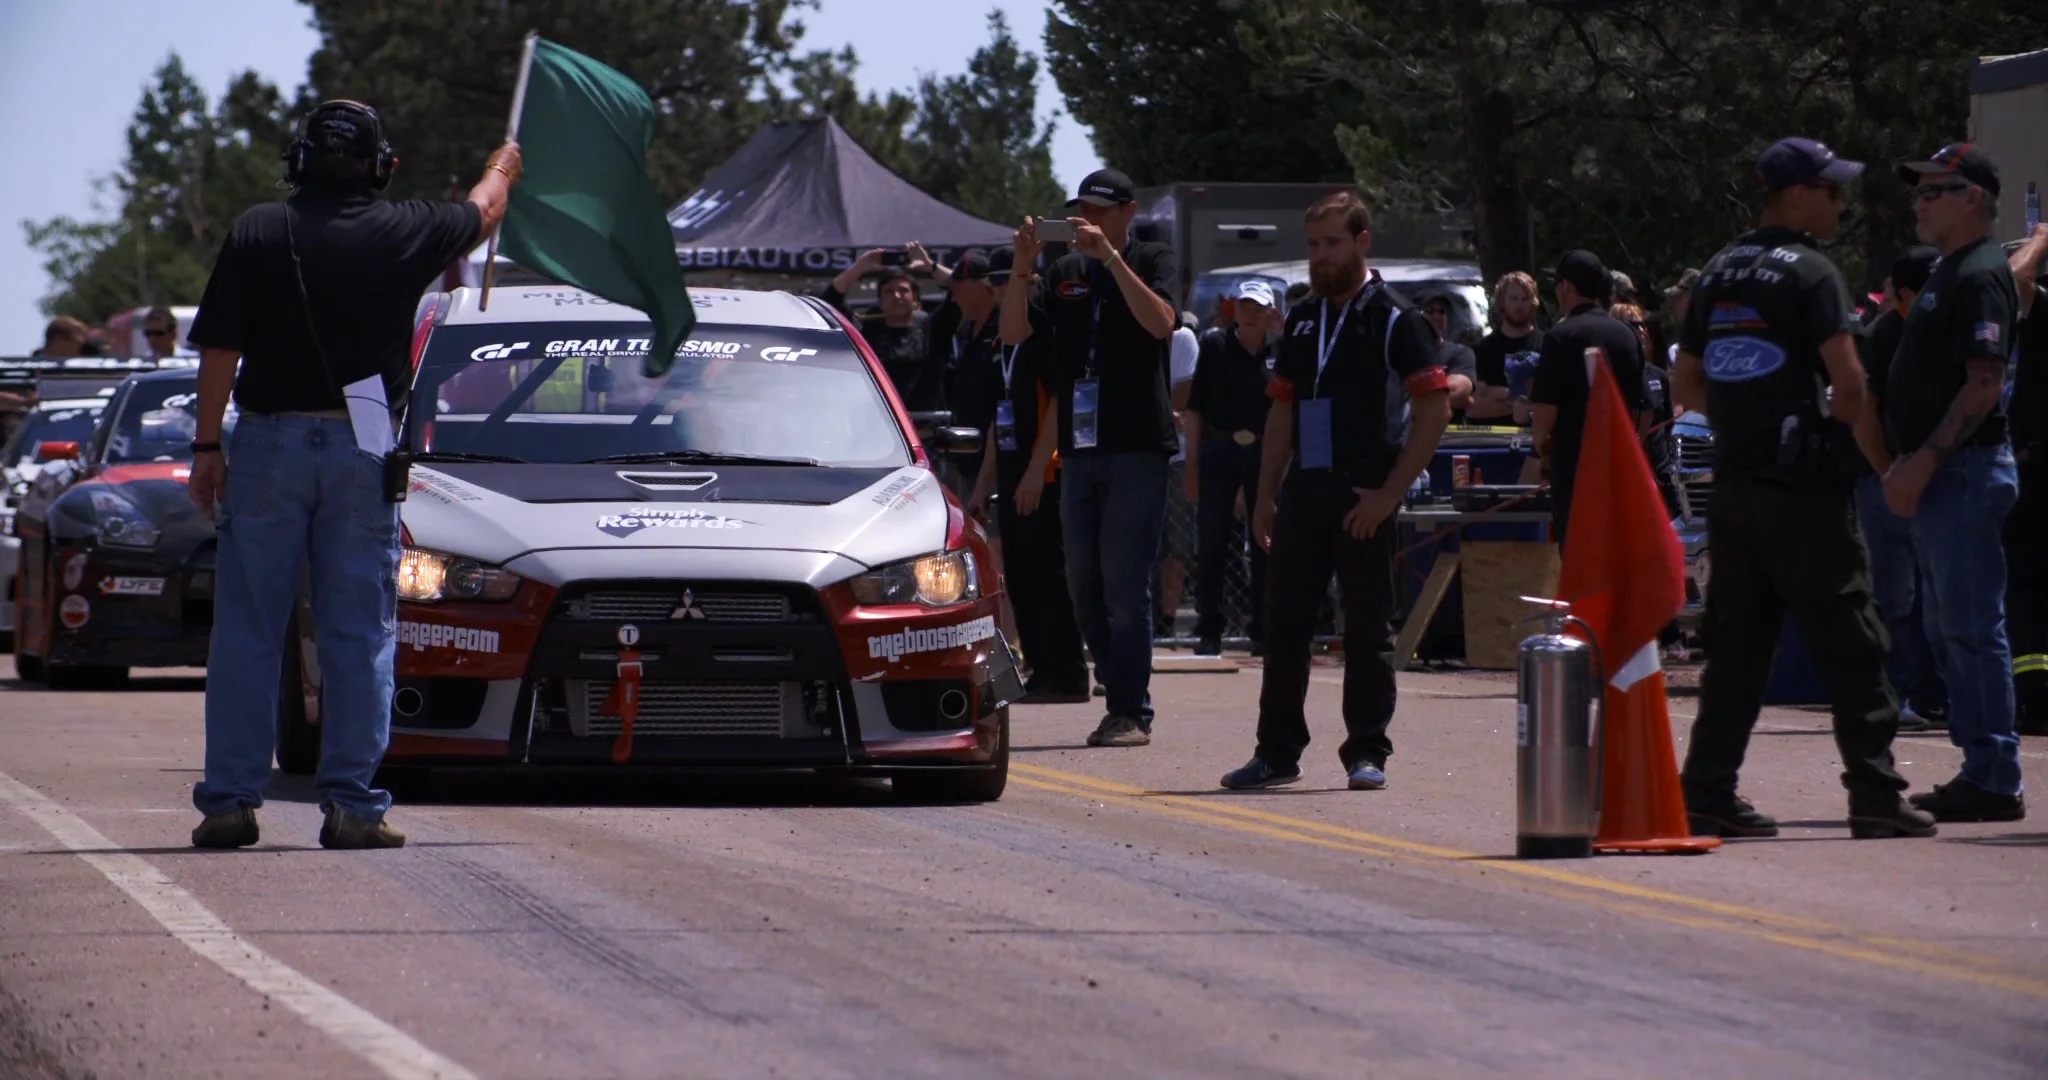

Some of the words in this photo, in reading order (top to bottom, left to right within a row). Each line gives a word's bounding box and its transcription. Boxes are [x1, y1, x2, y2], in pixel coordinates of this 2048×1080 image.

[553, 297, 714, 308] MOS
[545, 338, 620, 354] GRAN
[626, 338, 741, 354] TUSMO
[607, 350, 649, 358] DRIVIN
[674, 351, 735, 360] MULATOR
[628, 507, 710, 519] Simply
[597, 514, 743, 530] Rewards
